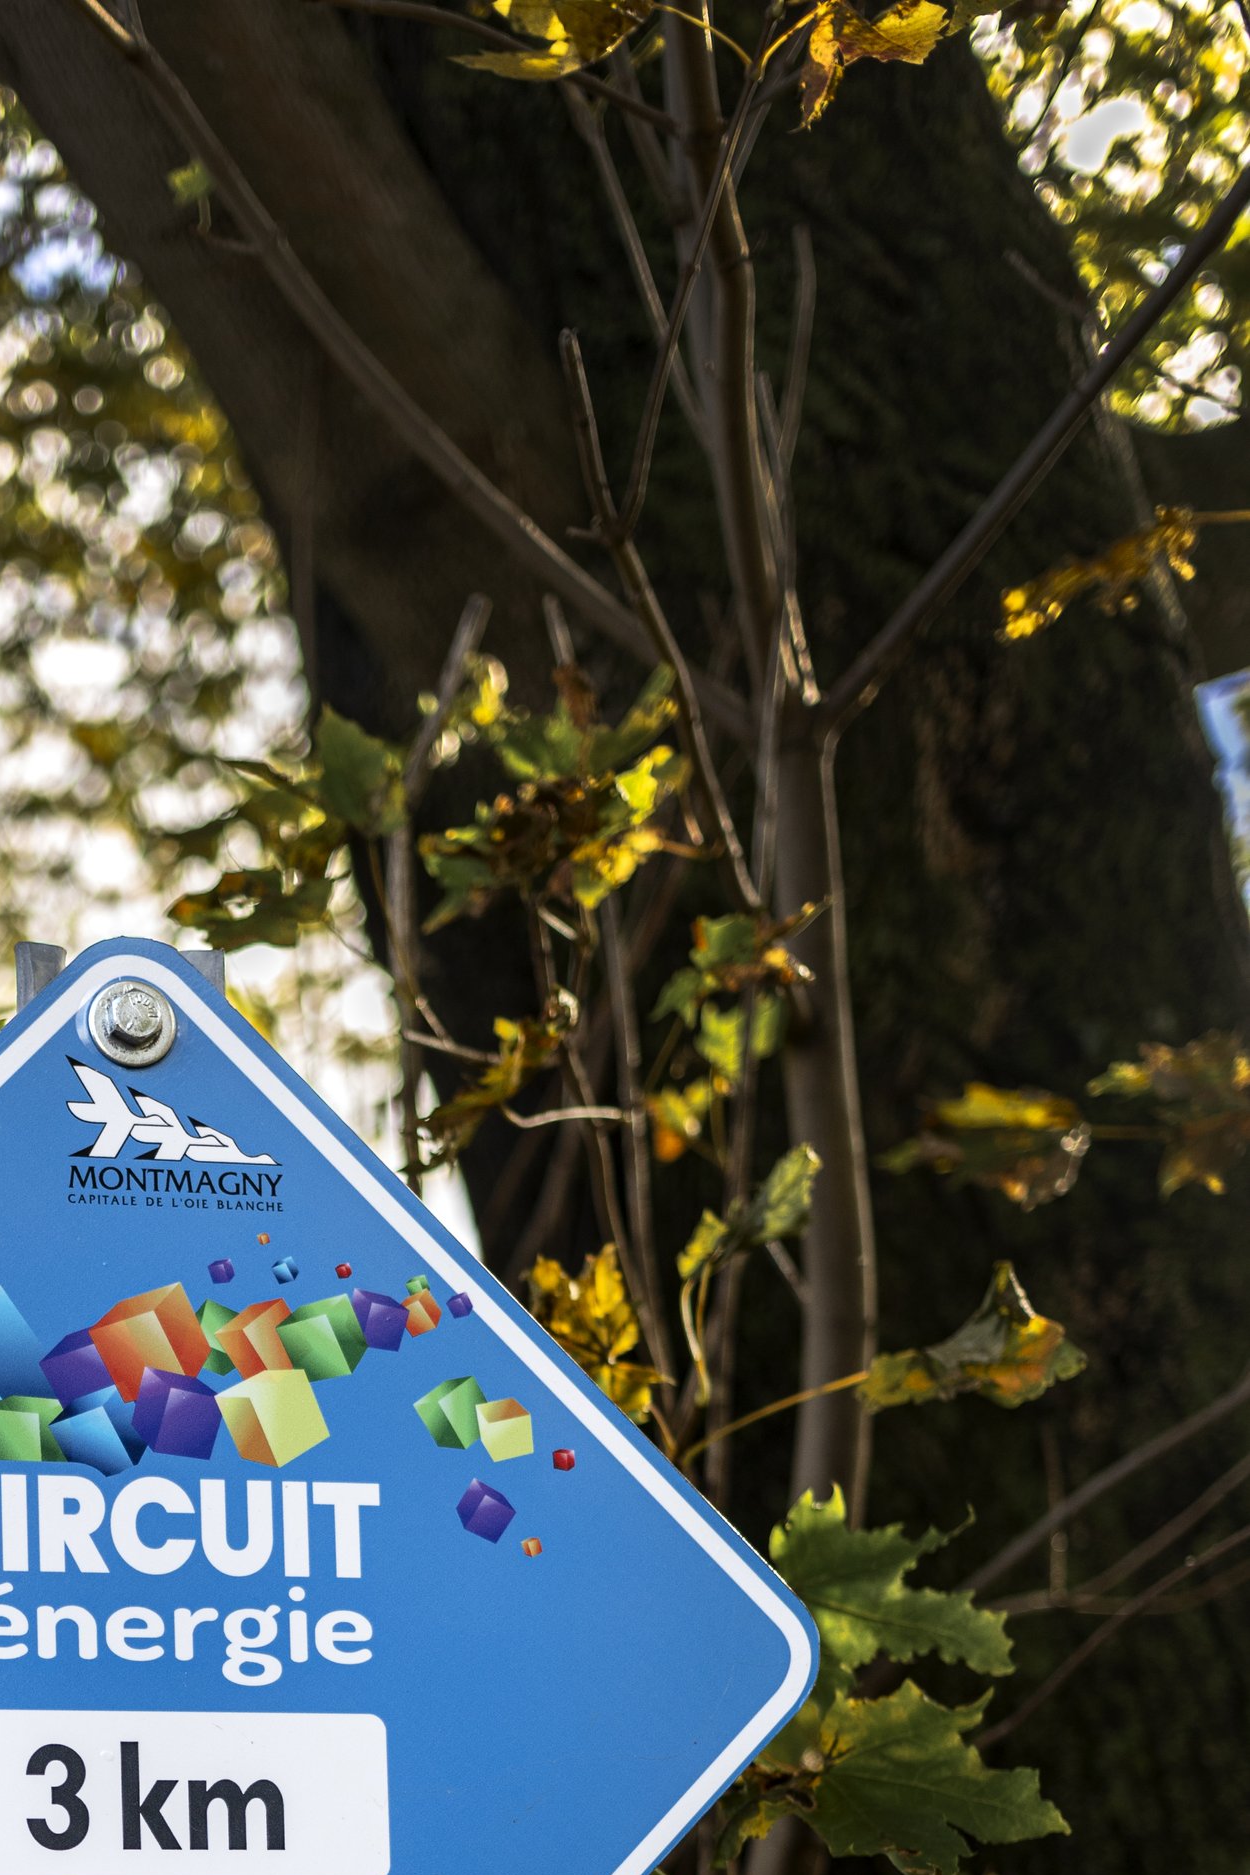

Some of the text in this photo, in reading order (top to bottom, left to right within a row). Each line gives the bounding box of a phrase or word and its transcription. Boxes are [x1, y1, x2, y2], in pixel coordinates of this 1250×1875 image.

[68, 1165, 283, 1197] MONTMAGNY
[67, 1193, 284, 1212] CAPITALE DE L'OIE BLANCHE
[25, 1740, 286, 1851] 3 km
